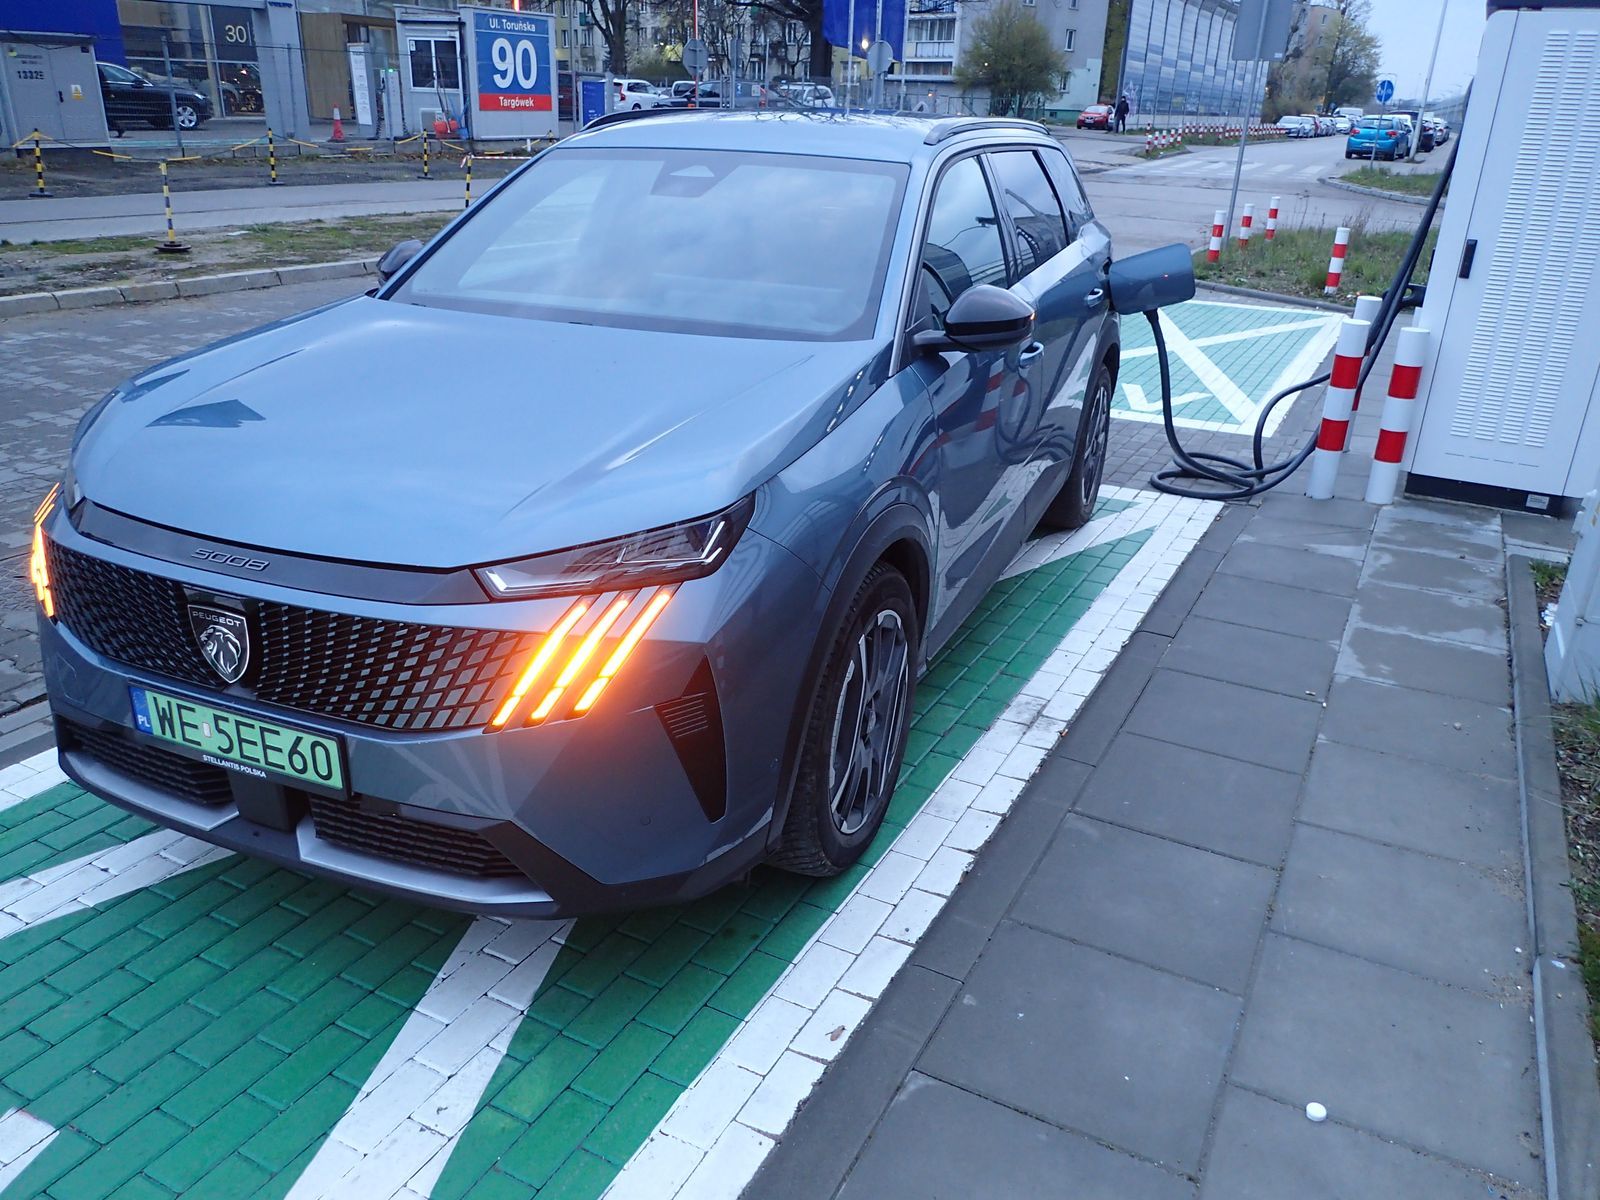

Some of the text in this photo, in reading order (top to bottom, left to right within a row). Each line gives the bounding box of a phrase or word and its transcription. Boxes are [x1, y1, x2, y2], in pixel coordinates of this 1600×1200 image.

[225, 25, 247, 43] 30
[502, 19, 536, 32] Toruńska
[491, 37, 537, 90] 90
[499, 96, 534, 109] Targówek
[191, 547, 270, 571] 5008
[192, 611, 242, 627] PEUGEOT
[138, 716, 150, 728] PL
[153, 696, 333, 780] WE 5EE60
[202, 755, 267, 778] STELLANTIS POLSKA
